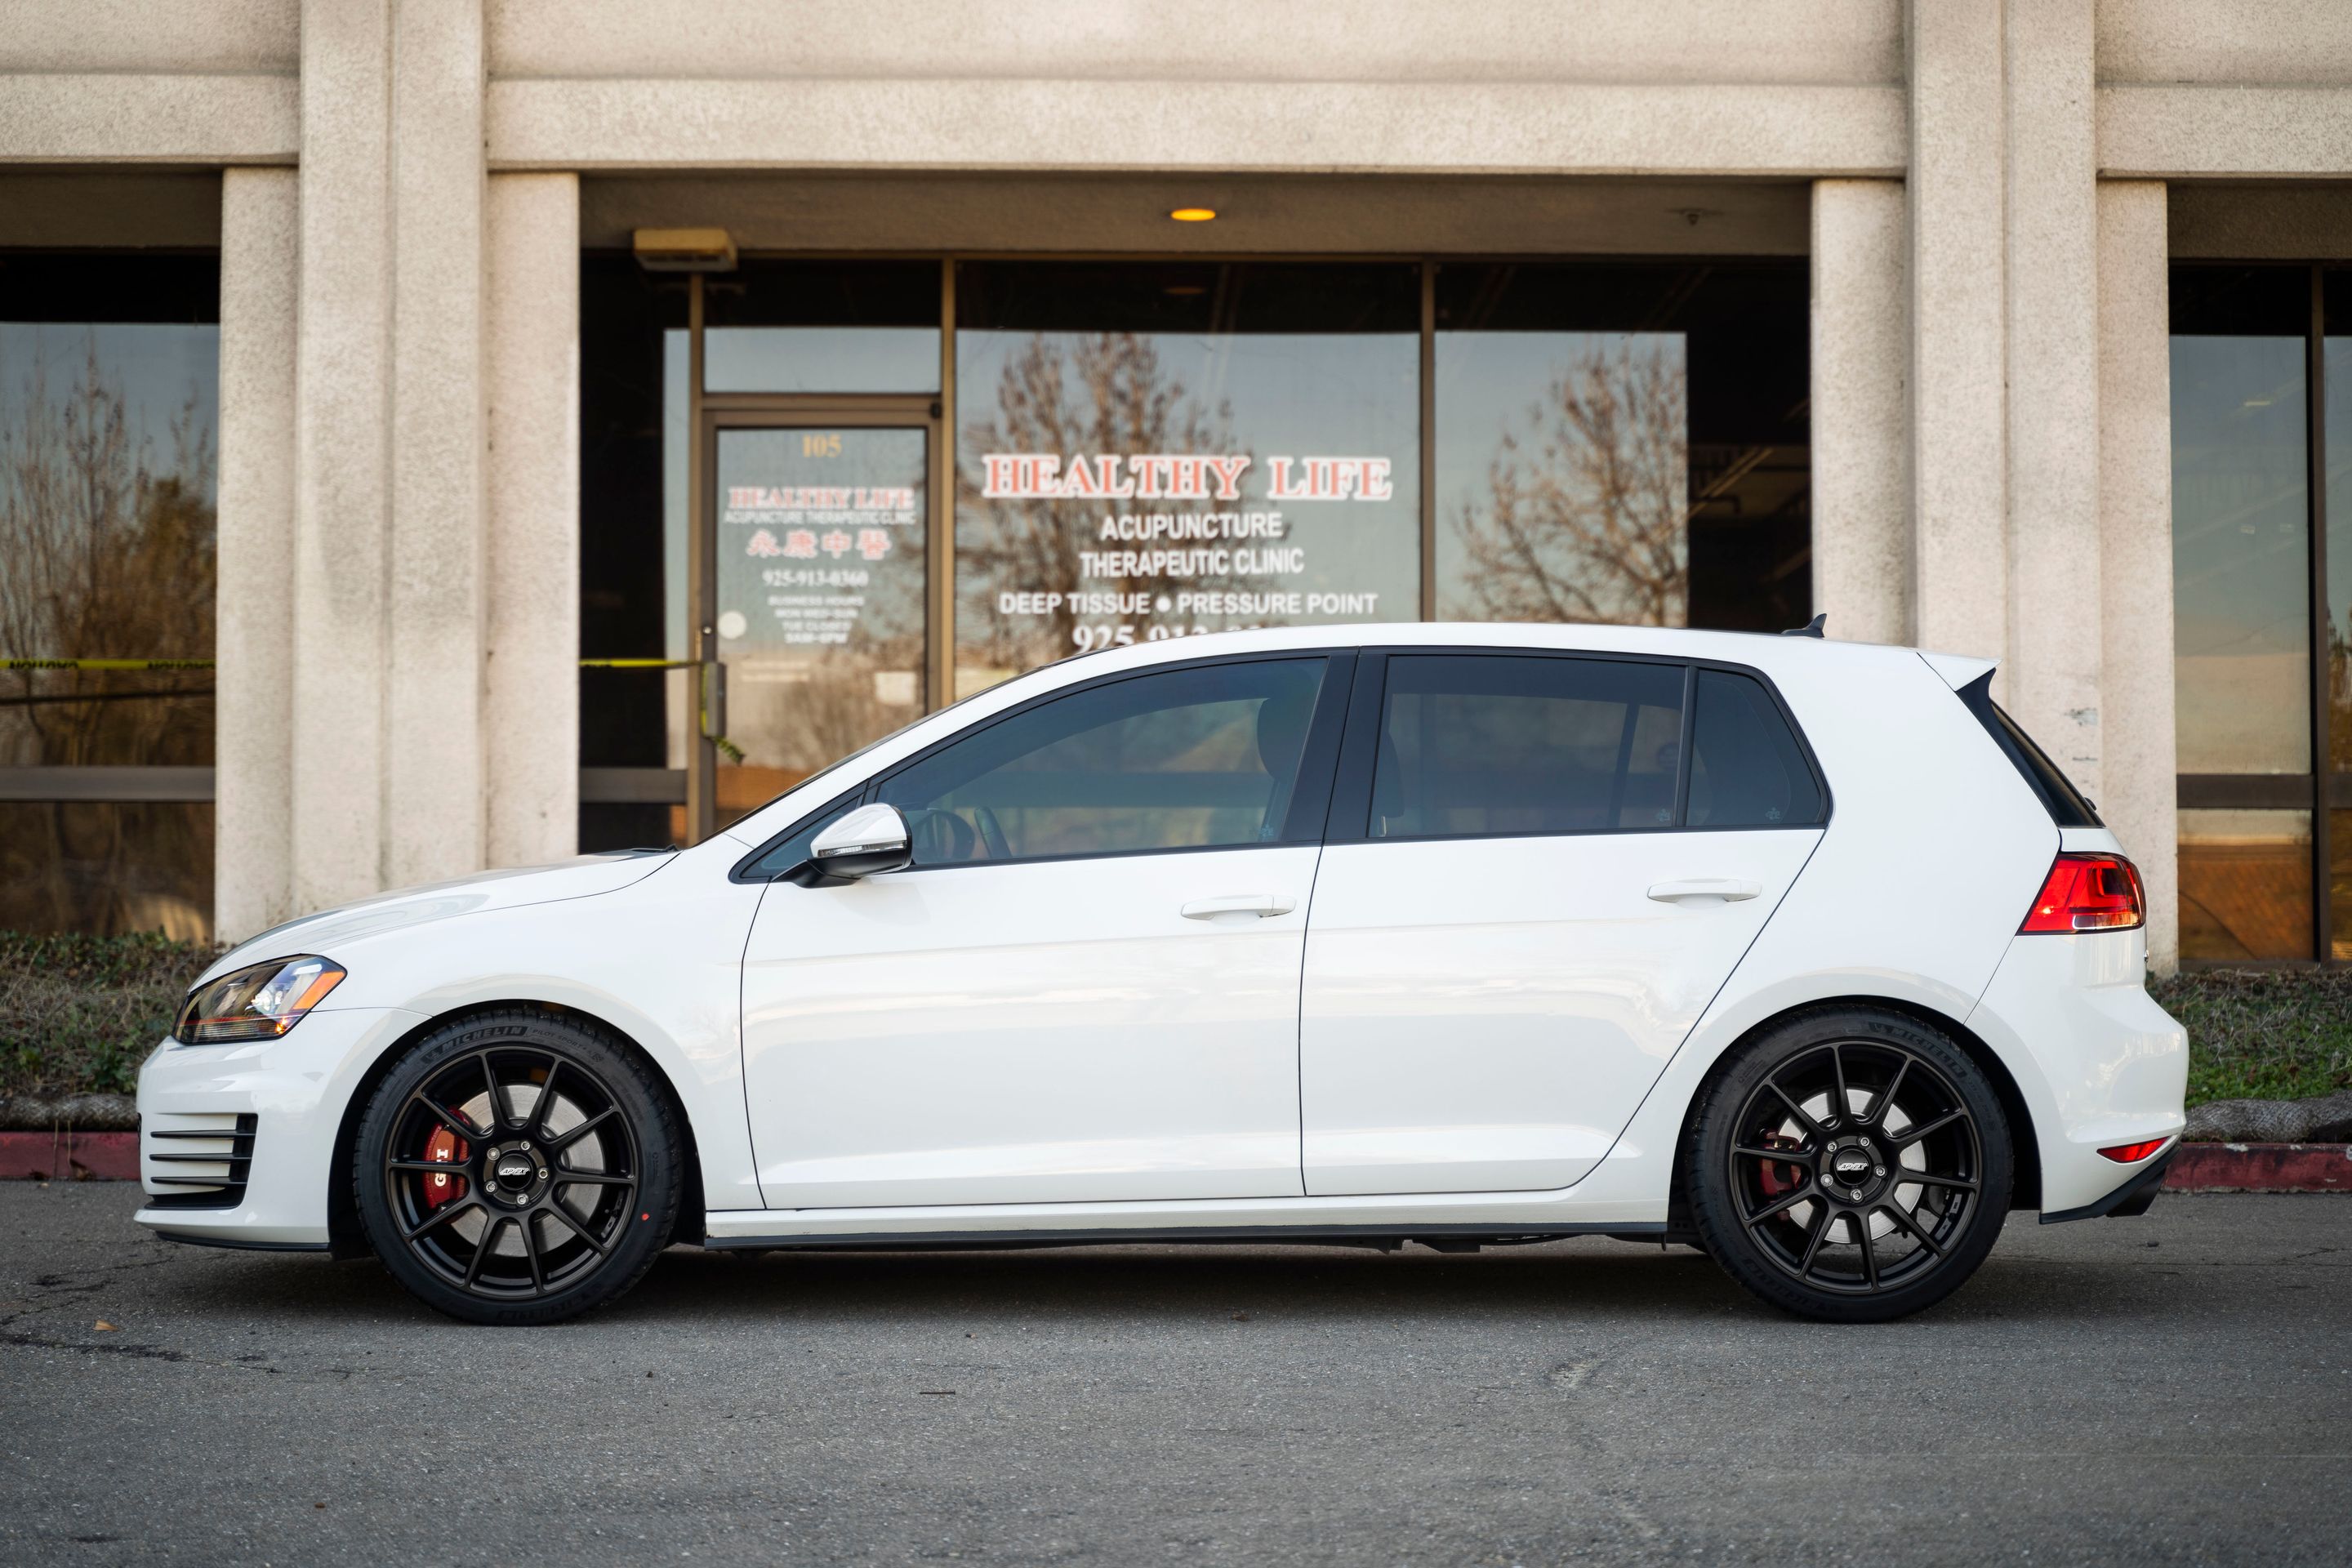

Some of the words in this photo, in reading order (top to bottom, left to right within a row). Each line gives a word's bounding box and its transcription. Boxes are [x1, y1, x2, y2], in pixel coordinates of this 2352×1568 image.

[802, 434, 842, 457] 105
[982, 453, 1250, 499] HEALTHY
[1267, 457, 1392, 501] LIFE
[728, 487, 852, 509] HEALTHY
[854, 487, 915, 509] LIFE
[1100, 511, 1283, 541] ACUPUNCTURE
[1080, 550, 1230, 578] THERAPEUTIC
[1234, 548, 1305, 575] CLINIC
[1000, 593, 1062, 615] DEEP
[1067, 593, 1151, 615] TISSUE
[1177, 593, 1302, 615] PRESSURE
[1307, 593, 1379, 615] POINT
[442, 1026, 523, 1051] MICHELIN
[434, 1148, 448, 1187] GI
